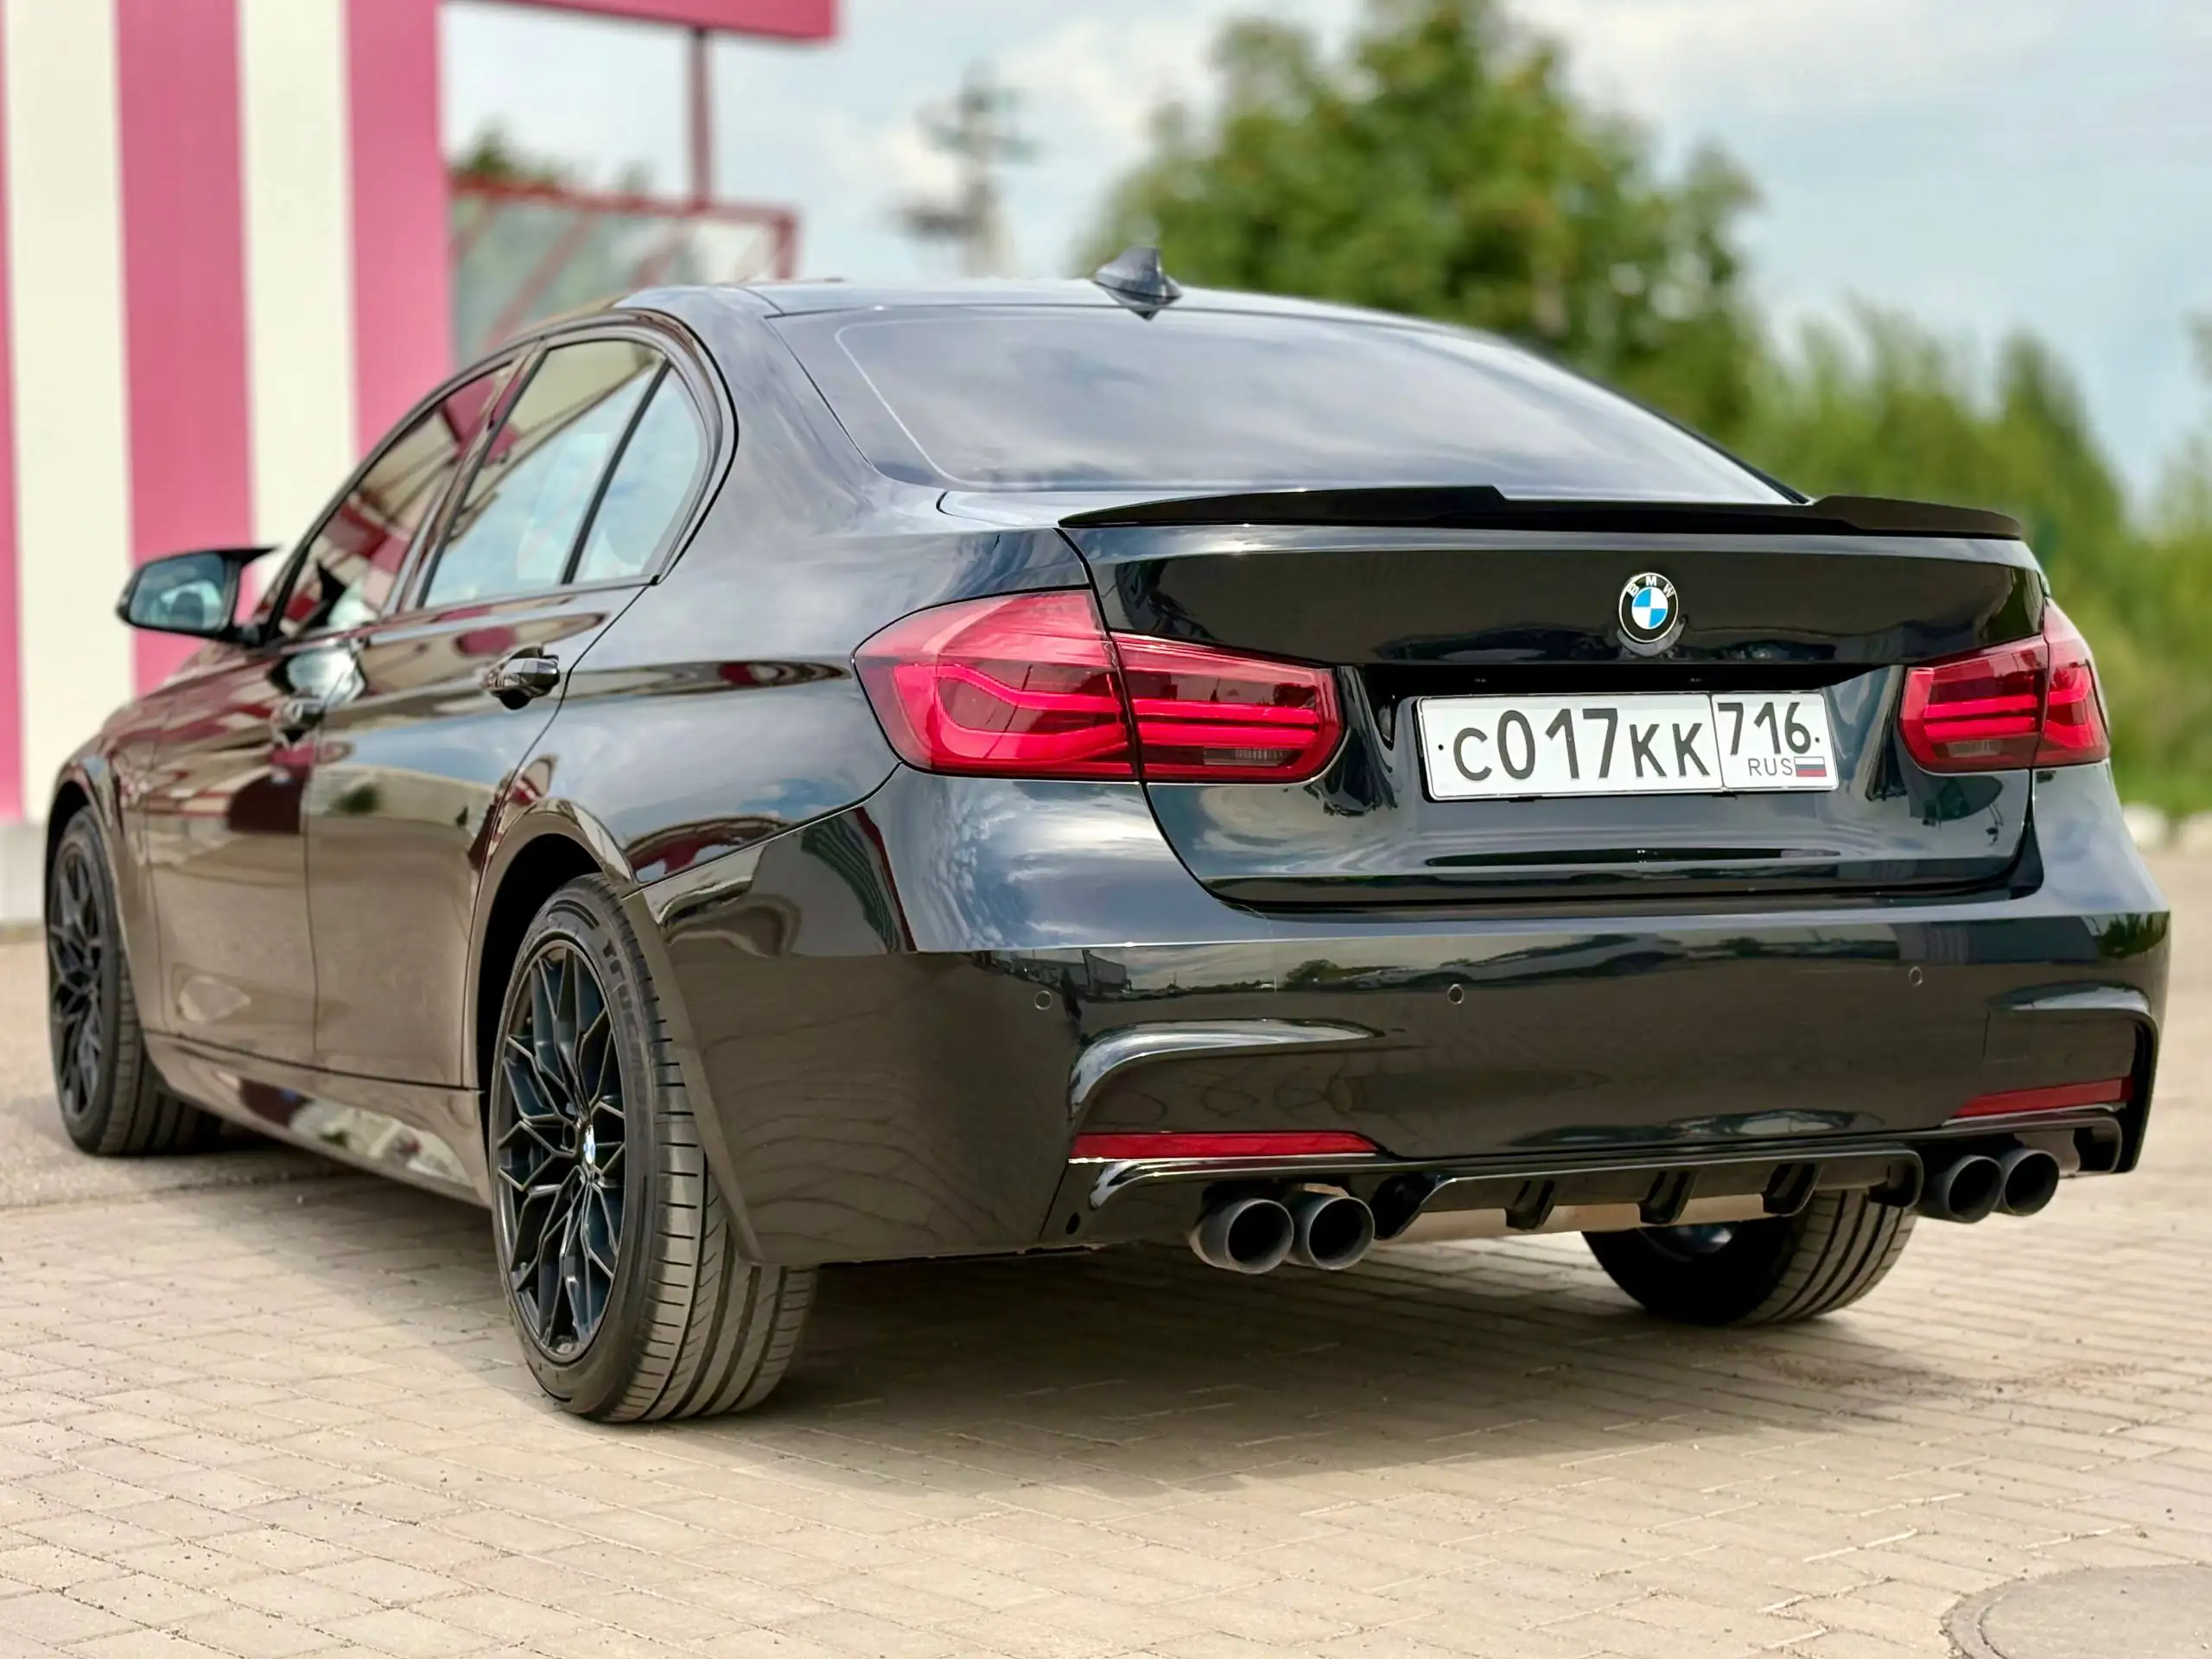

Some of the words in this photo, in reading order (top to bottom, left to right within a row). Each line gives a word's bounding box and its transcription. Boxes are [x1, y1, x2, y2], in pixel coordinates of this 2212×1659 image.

[1626, 575, 1675, 598] BMW
[1718, 702, 1812, 756] 716
[1747, 757, 1794, 777] RUS
